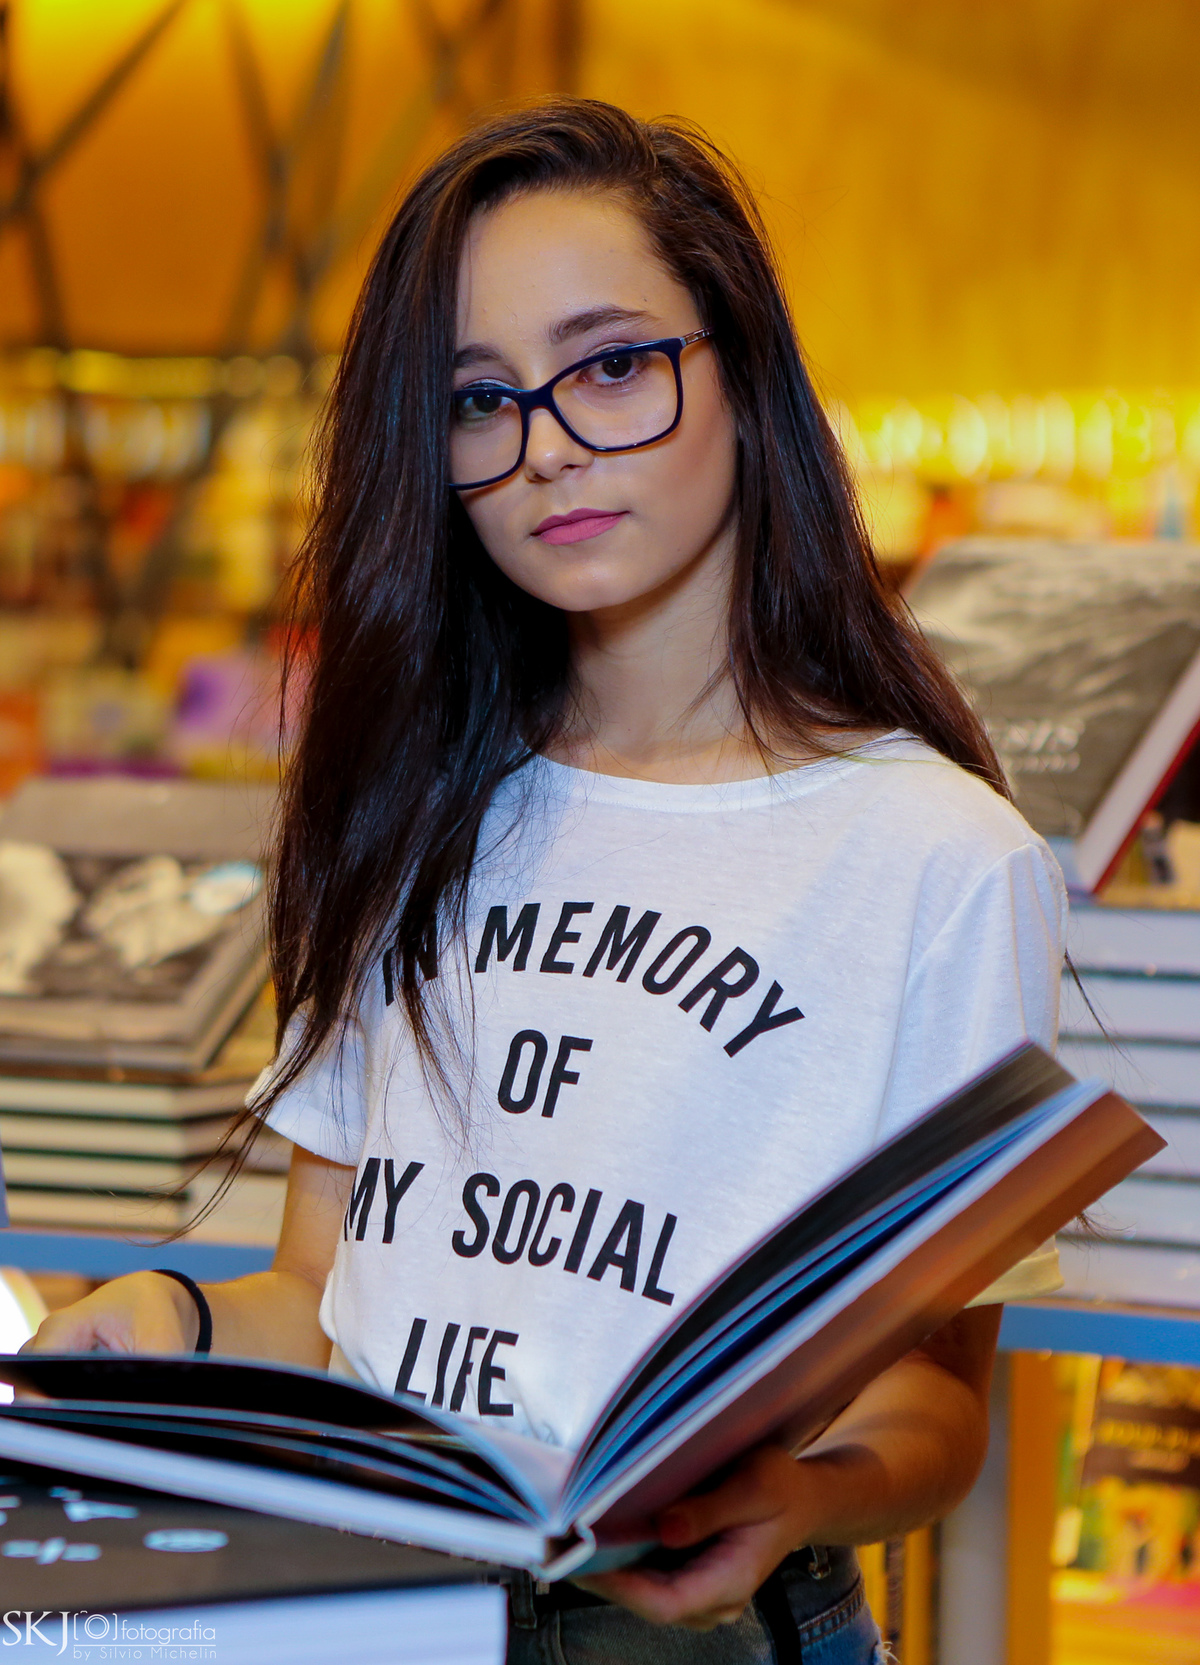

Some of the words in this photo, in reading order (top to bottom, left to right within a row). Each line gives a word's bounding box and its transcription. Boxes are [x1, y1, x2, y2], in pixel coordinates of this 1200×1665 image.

[475, 902, 805, 1058] MEMORY
[497, 1029, 594, 1118] OF
[344, 1157, 425, 1244] MY
[452, 1172, 678, 1306] SOCIAL
[394, 1317, 519, 1416] LIFE
